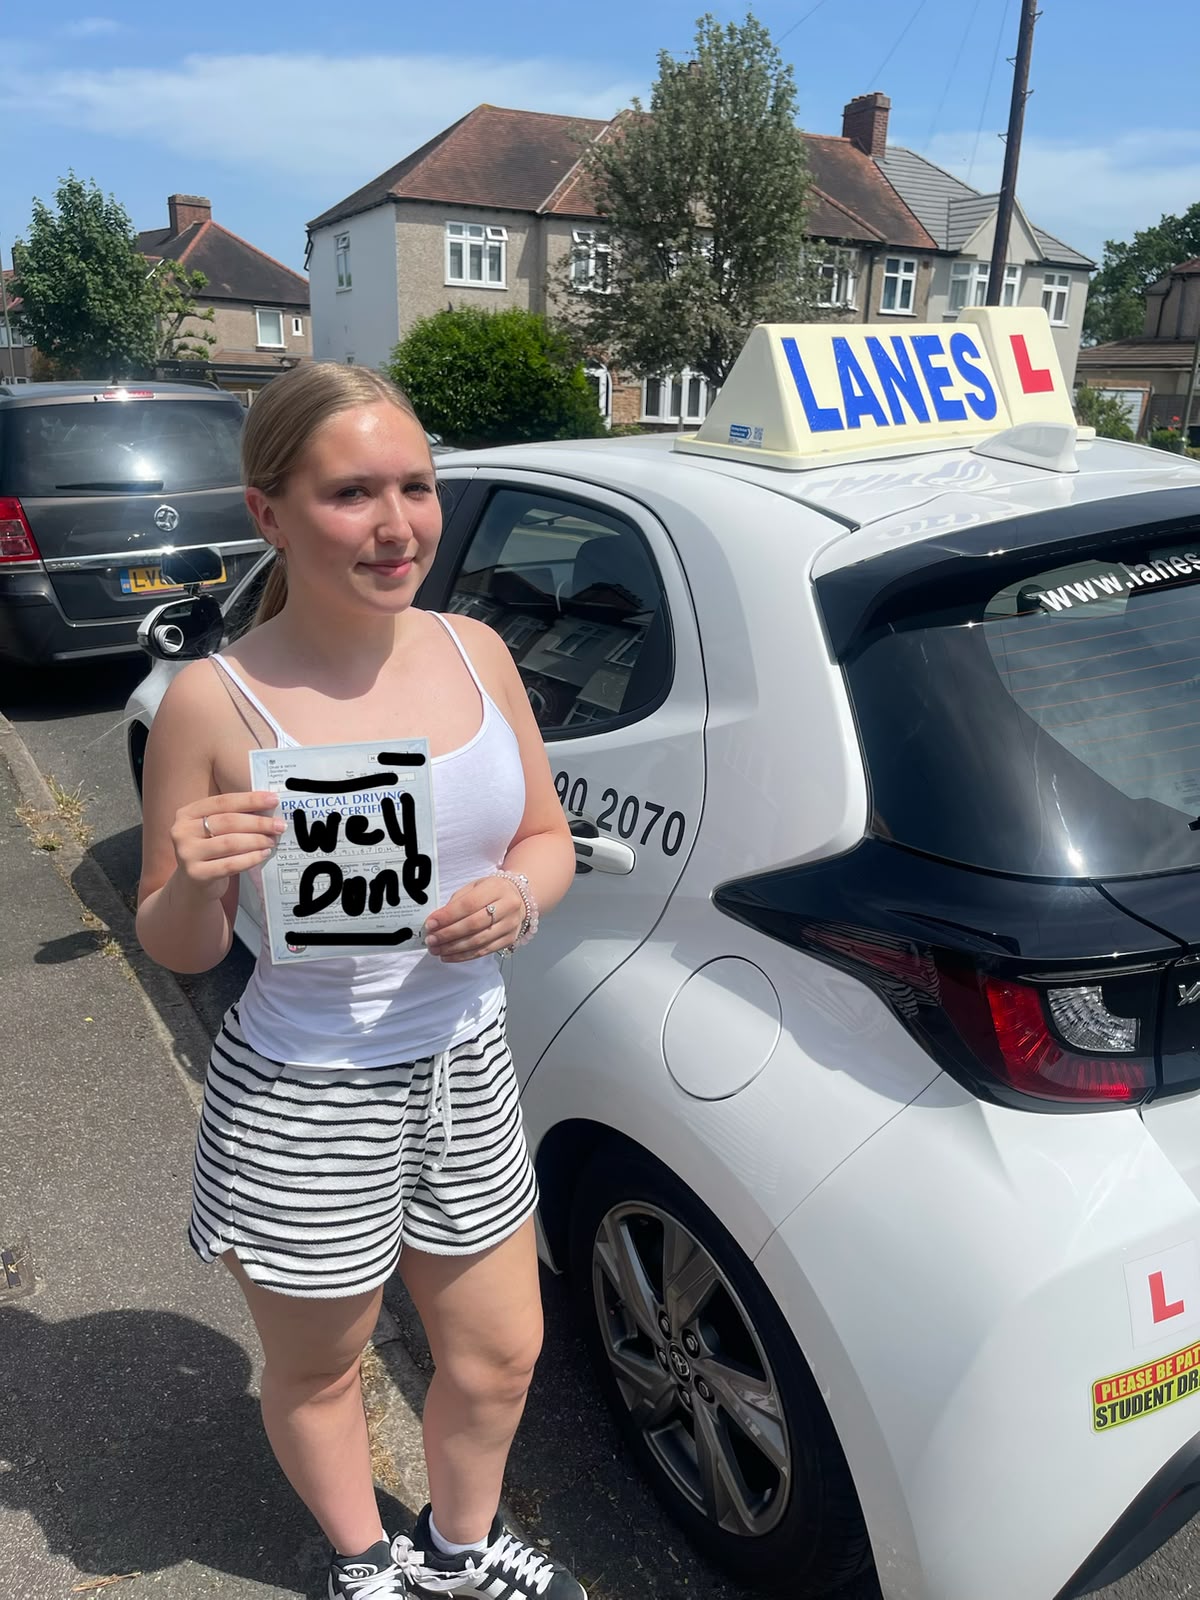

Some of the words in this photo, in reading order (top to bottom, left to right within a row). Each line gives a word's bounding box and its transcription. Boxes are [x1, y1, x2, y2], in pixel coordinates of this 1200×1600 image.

[780, 332, 998, 433] LANES
[1009, 334, 1055, 394] L
[132, 568, 161, 588] LV
[1038, 552, 1200, 612] www.lanes
[281, 793, 349, 811] PRACTICAL
[340, 801, 402, 816] CERTIFIT
[596, 787, 686, 857] 2070
[1148, 1270, 1185, 1324] L
[1101, 1367, 1154, 1401] PLEASE
[1156, 1358, 1173, 1380] BE
[1175, 1345, 1200, 1373] PAT
[1095, 1380, 1175, 1428] STUDENT
